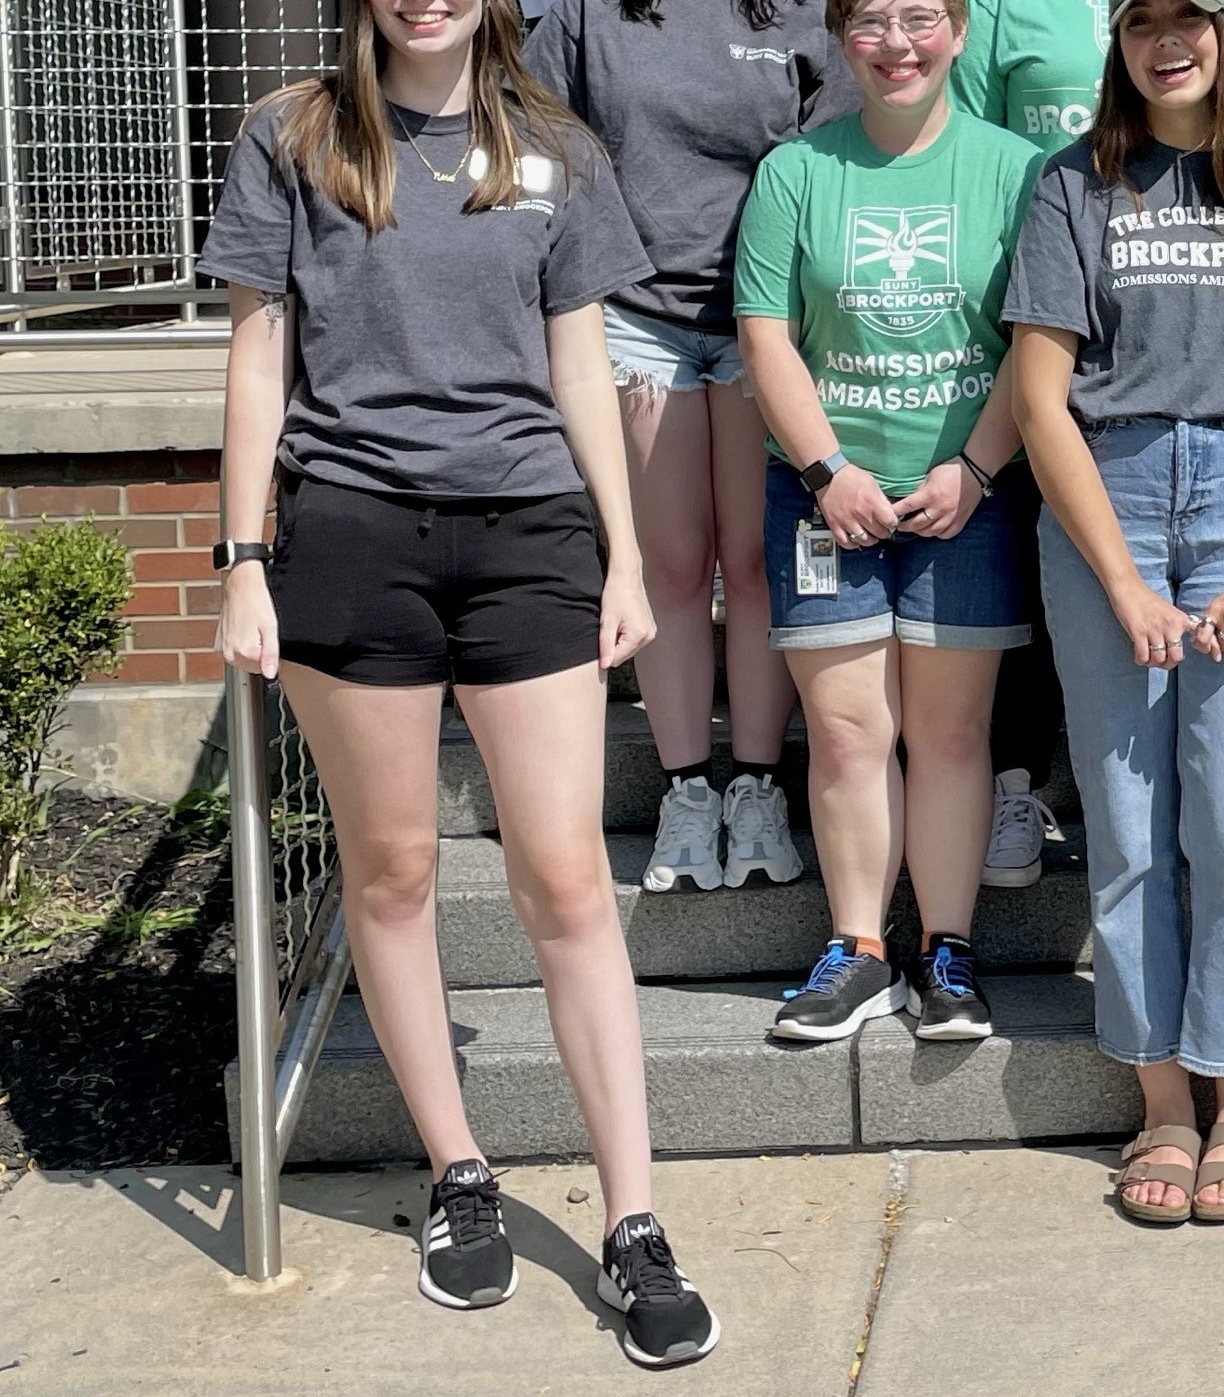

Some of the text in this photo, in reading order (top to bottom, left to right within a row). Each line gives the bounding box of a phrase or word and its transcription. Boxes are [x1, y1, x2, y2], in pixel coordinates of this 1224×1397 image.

[1023, 104, 1092, 135] BRO
[884, 280, 918, 291] SUNY
[1112, 273, 1197, 289] ADMISSIONS
[845, 292, 957, 308] BROCKPORT
[888, 315, 915, 327] 1835
[825, 344, 985, 378] ADMISSIONS
[817, 371, 996, 411] AMBASSADOR
